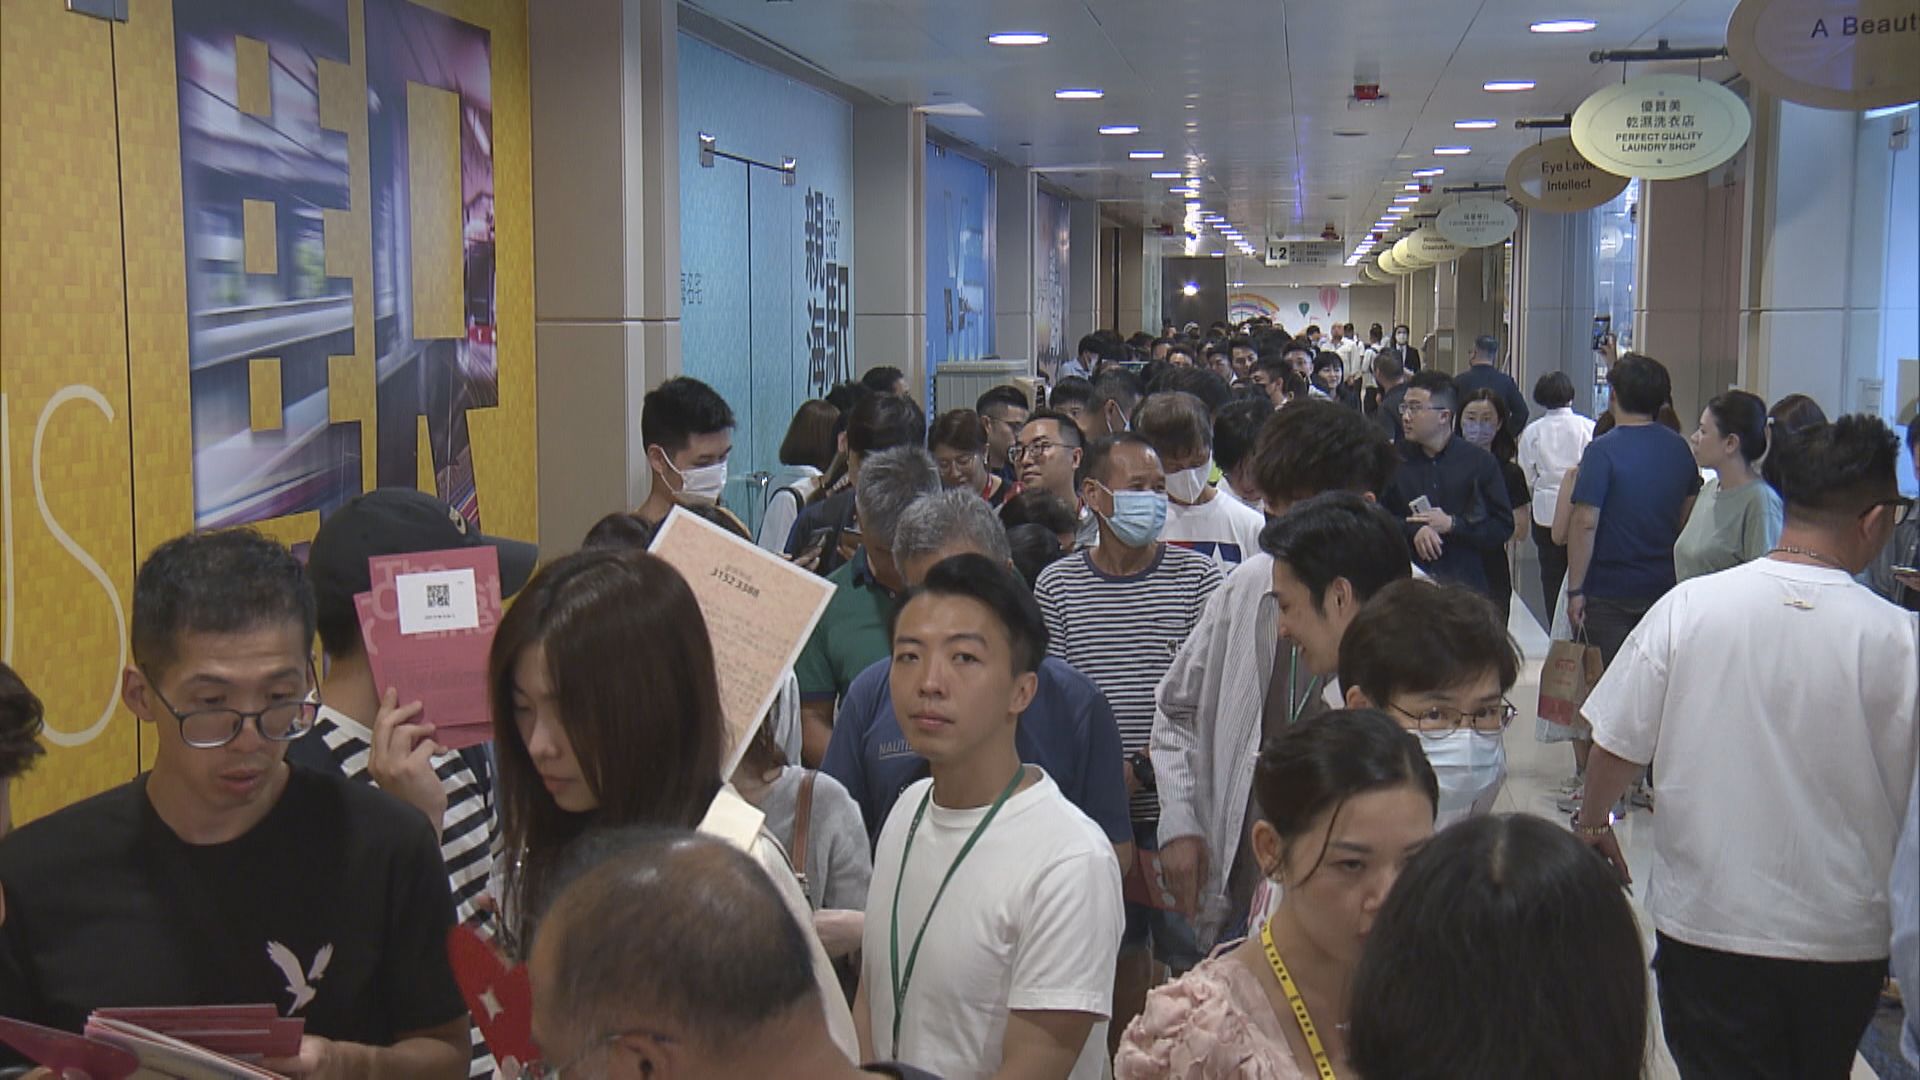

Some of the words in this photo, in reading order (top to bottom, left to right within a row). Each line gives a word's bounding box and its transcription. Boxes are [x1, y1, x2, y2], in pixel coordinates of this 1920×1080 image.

[1810, 18, 1828, 38] A
[1843, 12, 1919, 36] Beaut
[1615, 133, 1659, 142] PERFECT
[1661, 131, 1703, 141] QUALITY
[1621, 143, 1667, 152] LAUNDRY
[1668, 142, 1696, 151] SHOP
[1541, 161, 1563, 174] Eye
[1565, 160, 1597, 172] Leve
[1547, 178, 1592, 192] Intellect
[825, 197, 835, 217] THE
[825, 219, 841, 238] COAST
[1269, 246, 1287, 260] L2
